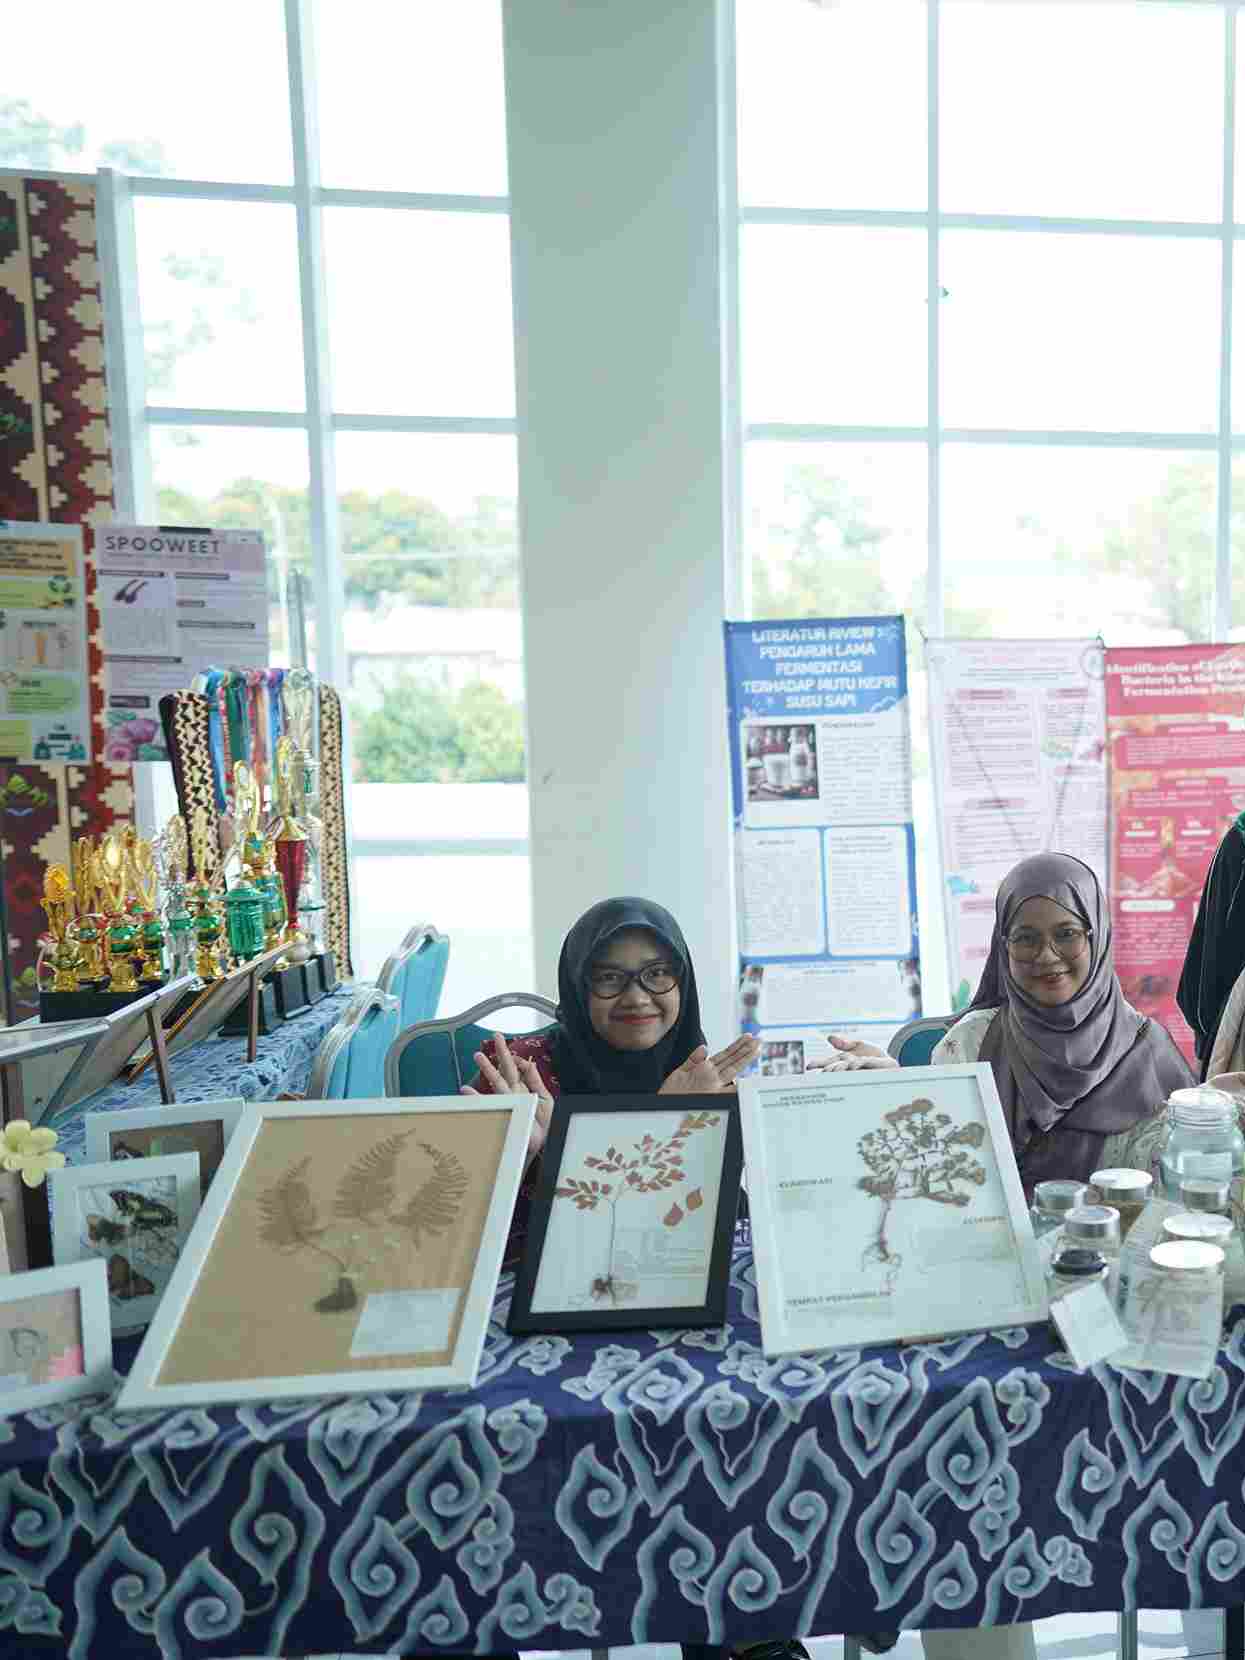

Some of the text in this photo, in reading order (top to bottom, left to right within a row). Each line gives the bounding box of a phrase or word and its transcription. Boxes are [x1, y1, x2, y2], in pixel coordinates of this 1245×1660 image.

[105, 536, 221, 554] SPOOWEET
[836, 642, 876, 657] LAMA
[784, 694, 857, 709] SUSU SAPI
